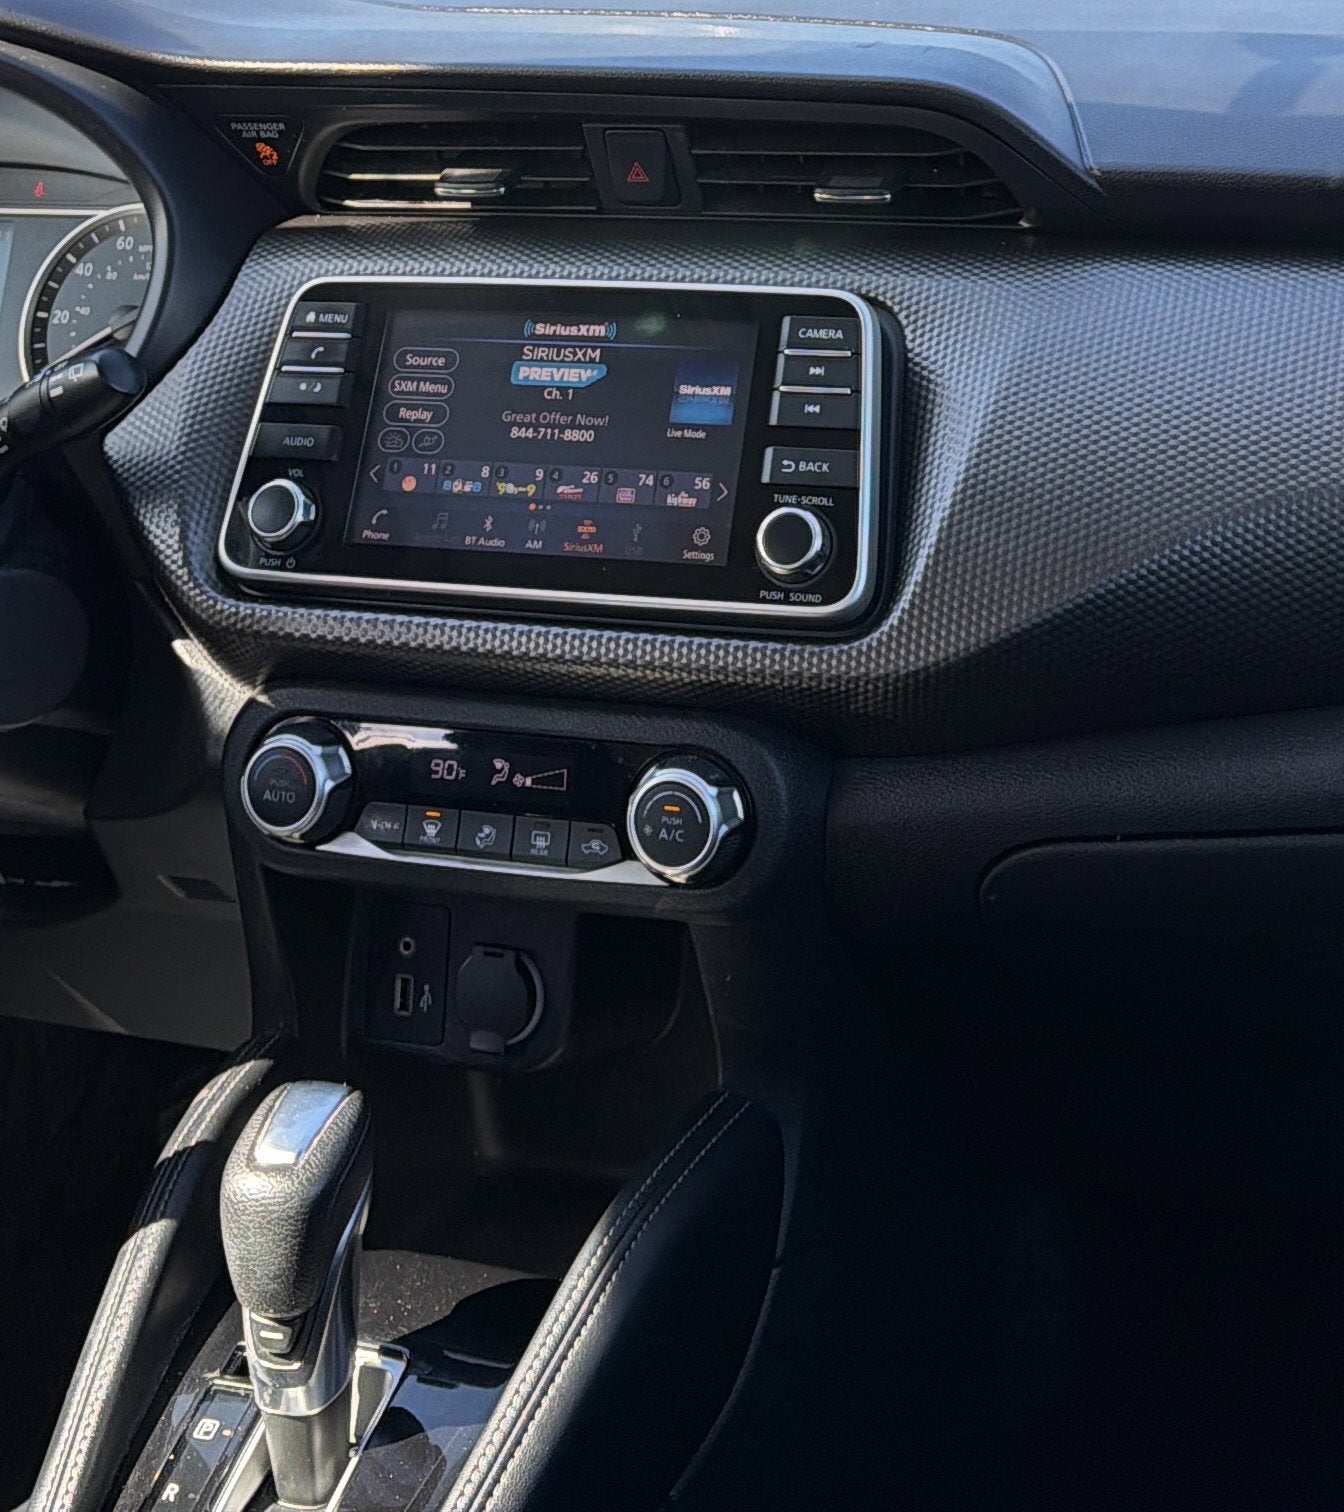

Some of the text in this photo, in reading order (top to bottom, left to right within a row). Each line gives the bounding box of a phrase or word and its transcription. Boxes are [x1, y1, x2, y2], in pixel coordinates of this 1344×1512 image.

[230, 122, 287, 131] PASSENGER
[115, 236, 134, 251] 60
[74, 261, 94, 277] 40
[51, 309, 70, 324] 20
[318, 312, 350, 325] MENU
[798, 327, 844, 340] CAMERA
[404, 353, 446, 368] Source
[521, 345, 602, 363] SIRIUSXM
[517, 366, 598, 384] PREVIEW
[392, 380, 449, 395] SXM Menu
[543, 387, 574, 402] Ch. 1
[678, 383, 732, 398] SiriusXM
[398, 406, 434, 423] Replay
[501, 410, 610, 428] Great Offer Now!
[509, 427, 596, 443] 844-711-8800
[666, 427, 708, 441] Live Mode
[282, 436, 315, 448] AUDIO
[287, 468, 305, 478] VOL
[422, 462, 438, 476] 11
[480, 465, 491, 478] 8
[798, 461, 831, 473] BACK
[534, 468, 545, 481] 9
[581, 470, 599, 484] 26
[638, 473, 655, 487] 74
[693, 476, 711, 490] 56
[361, 528, 391, 542] Phone
[464, 535, 476, 547] BT
[476, 536, 507, 549] Audio
[524, 538, 543, 550] AM
[563, 541, 604, 555] SiriusXM
[259, 556, 281, 568] PUSH
[682, 549, 716, 563] Settings
[759, 590, 823, 604] PUSH SOUND
[262, 789, 296, 804] AUTO
[660, 816, 683, 826] PUSH
[658, 828, 685, 842] A/C
[160, 1482, 180, 1503] R
